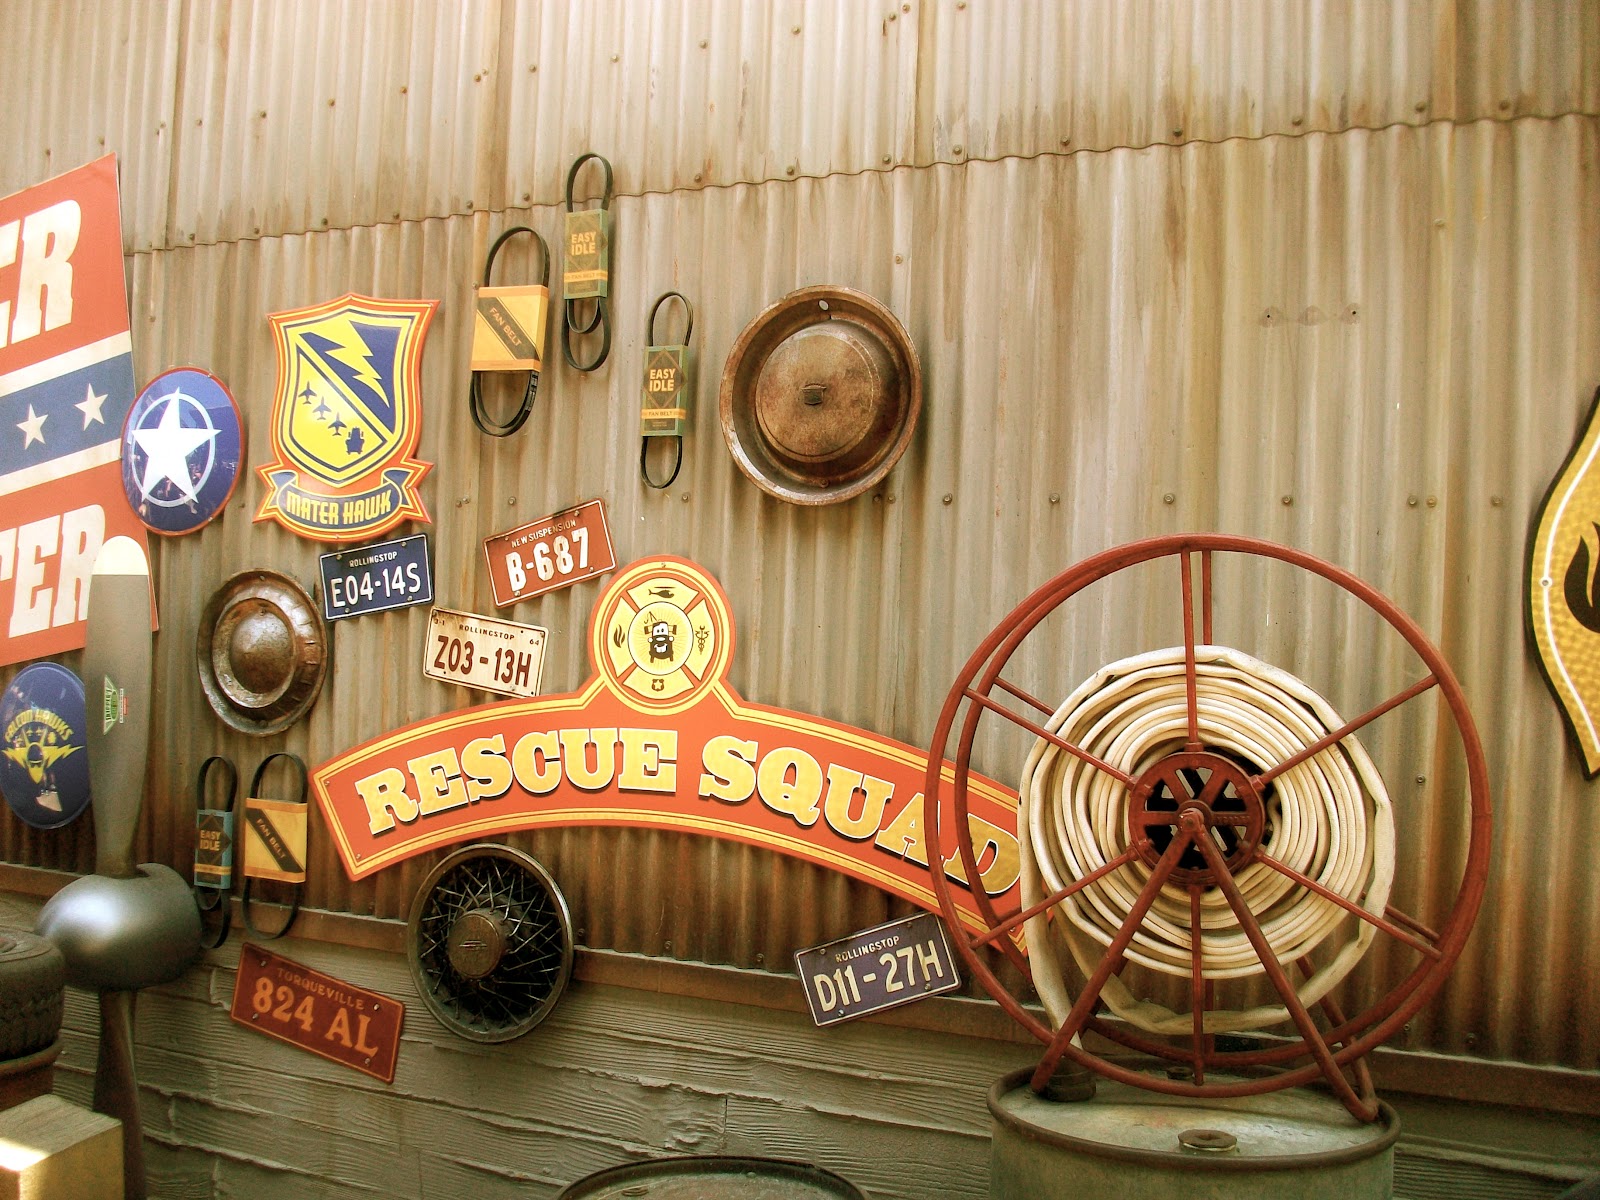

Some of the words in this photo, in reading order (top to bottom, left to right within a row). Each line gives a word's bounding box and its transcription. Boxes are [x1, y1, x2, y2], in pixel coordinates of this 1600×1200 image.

[571, 231, 596, 243] EASY
[571, 242, 596, 256] IDLE
[490, 307, 505, 326] FAN
[503, 325, 522, 346] BELT
[649, 379, 674, 392] IDLE
[650, 368, 676, 380] EASY
[286, 490, 339, 525] MATER
[342, 489, 392, 525] HAWK
[511, 536, 528, 548] NEW
[528, 519, 577, 542] SUSPENSION
[349, 551, 398, 568] ROLLINGSTOP
[505, 526, 589, 592] B-687
[330, 562, 421, 608] E04-14S
[459, 623, 515, 641] ROLLINGSTOP
[529, 638, 540, 646] 64
[354, 727, 679, 838] RESCUE
[698, 735, 1021, 896] SQUAD
[200, 829, 221, 840] EASY
[200, 840, 220, 851] IDLE
[256, 818, 270, 837] FAN
[269, 837, 286, 859] BELT
[834, 935, 901, 963] ROLLINGSTOP
[277, 967, 364, 1010] TORQUEVILLE
[252, 976, 316, 1032] 824
[324, 1007, 379, 1058] AL
